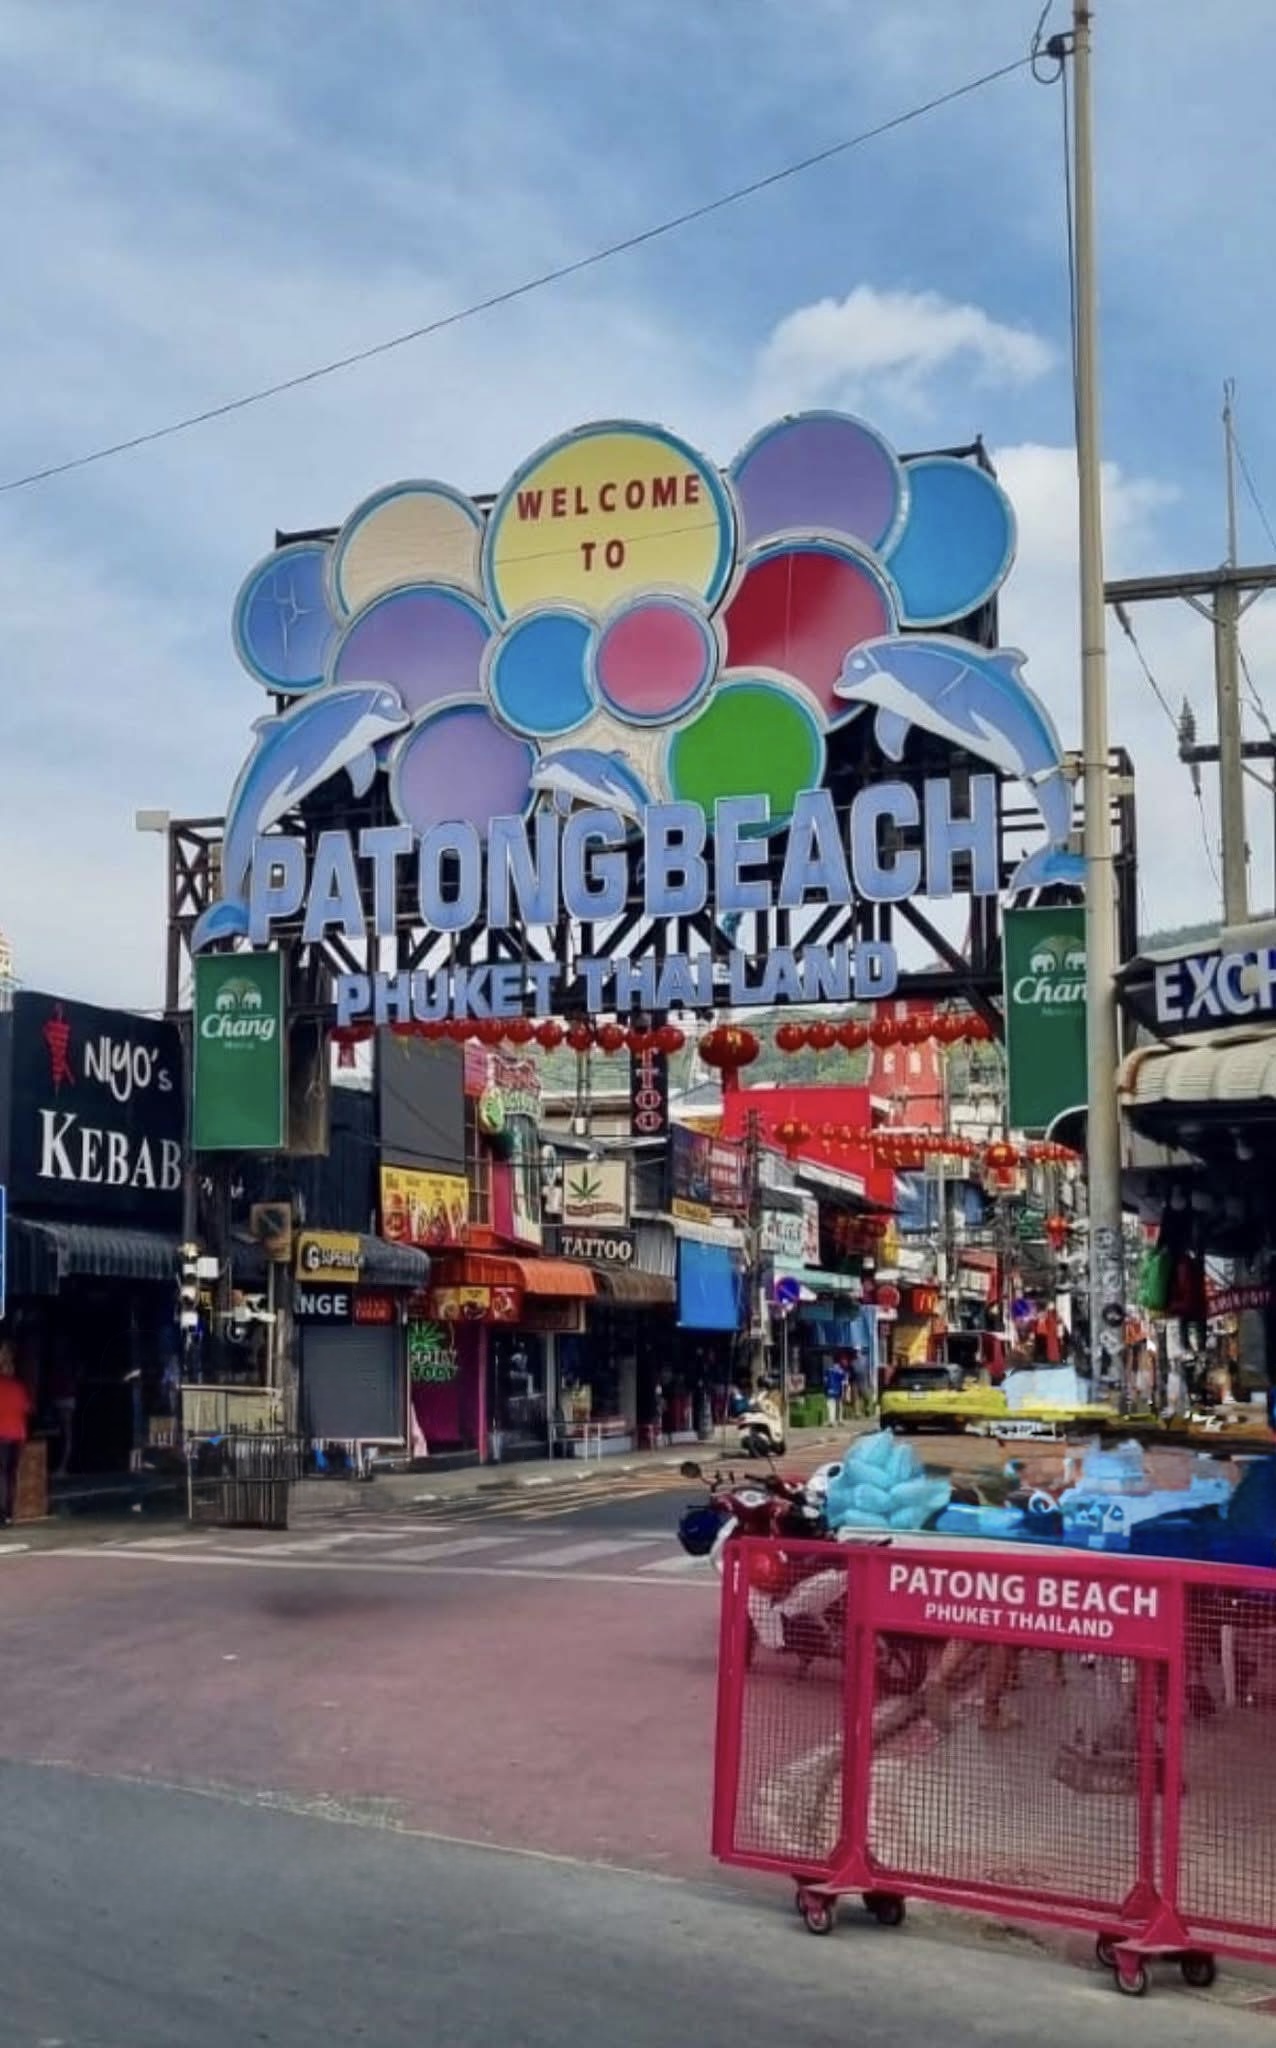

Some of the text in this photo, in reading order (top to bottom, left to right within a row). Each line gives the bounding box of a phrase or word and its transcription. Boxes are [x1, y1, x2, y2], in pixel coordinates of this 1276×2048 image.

[517, 473, 700, 521] WELCOME
[580, 538, 625, 572] TO
[248, 774, 999, 945] PATONG BEACH
[336, 941, 898, 1027] PHUKET THAILAND
[1013, 976, 1087, 1004] Chan
[200, 1013, 276, 1042] Chang
[37, 1108, 182, 1190] KEBAB
[561, 1236, 632, 1260] TATTOO
[888, 1563, 1159, 1617] PATONG BEACH
[924, 1602, 1114, 1638] PHUKET THAILAND
